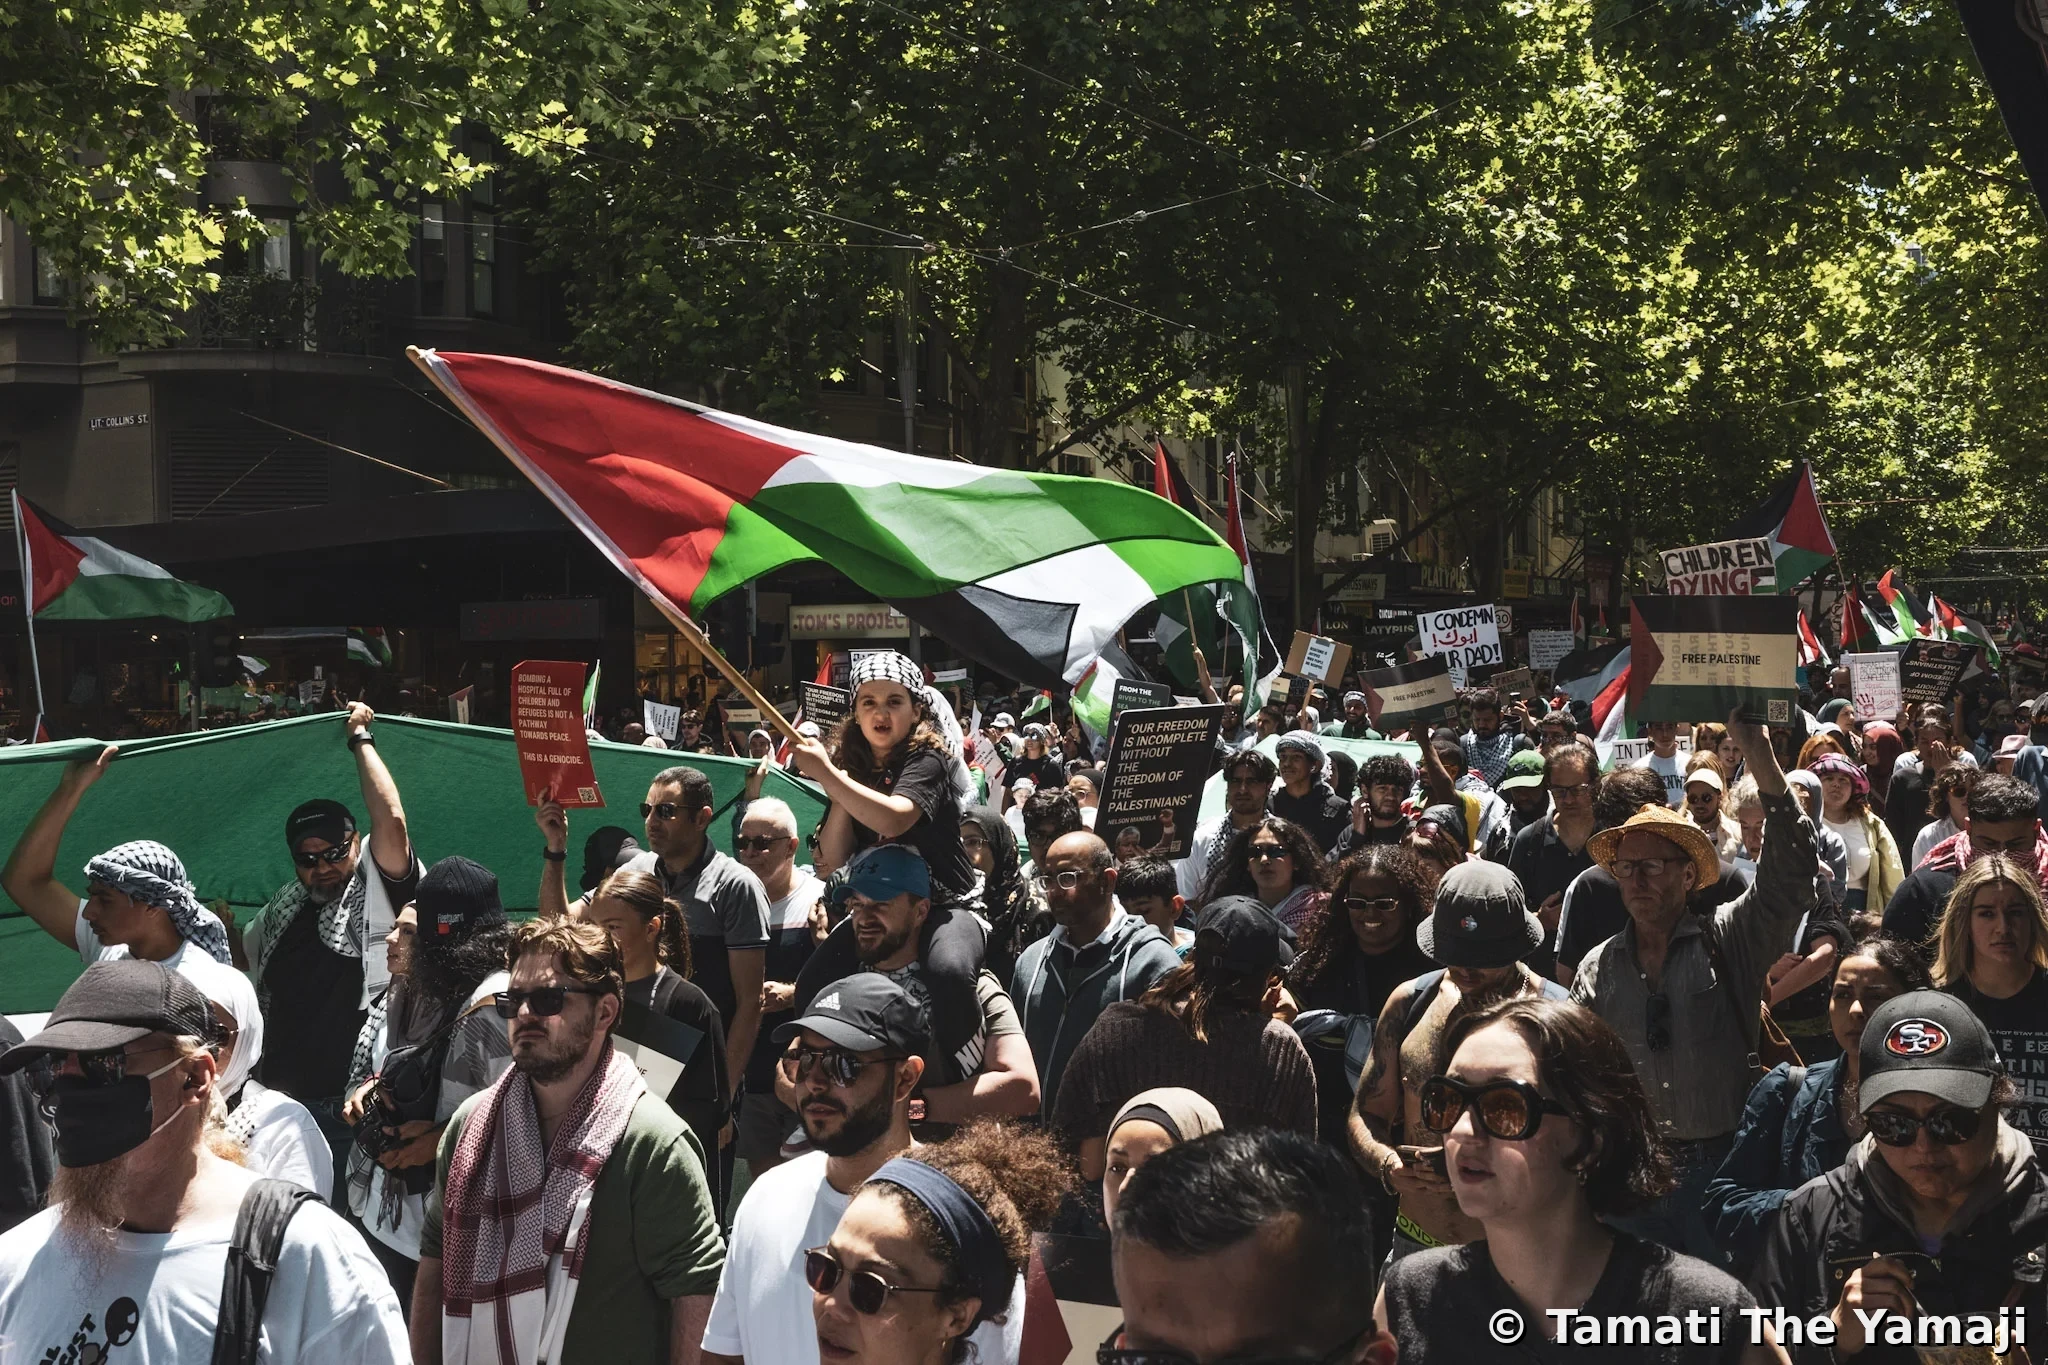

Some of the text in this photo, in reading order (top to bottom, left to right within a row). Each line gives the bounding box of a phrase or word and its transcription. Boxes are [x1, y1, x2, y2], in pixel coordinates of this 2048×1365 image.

[106, 416, 134, 426] COLLINS
[1664, 540, 1774, 577] CHILDREN
[1422, 565, 1468, 590] PLATYPUS
[1670, 568, 1750, 595] DYING
[1422, 606, 1494, 632] I CONDEMN
[1496, 614, 1508, 624] 30
[1424, 643, 1500, 668] YUR DAD!
[1682, 654, 1761, 665] FREE PALESTINE
[518, 674, 546, 683] BOMBING
[1921, 673, 1955, 681] FREEDOM
[518, 686, 572, 696] HOSPITAL FULL OF
[1119, 686, 1152, 696] FROM THE
[1406, 688, 1436, 699] PALESTINE
[518, 697, 560, 707] CHILDREN AND
[1118, 694, 1137, 702] RIVER
[518, 708, 574, 720] REFUGEES IS NOT A
[519, 719, 548, 728] PATHWAY
[1156, 718, 1210, 732] FREEDOM
[520, 730, 571, 742] TOWARDS PEACE.
[1123, 731, 1208, 748] IS INCOMPLETE
[523, 752, 584, 764] THIS IS A GENOCIDE.
[1120, 746, 1172, 760] WITHOUT
[1615, 744, 1632, 760] IN
[1118, 762, 1140, 773] THE
[1114, 770, 1184, 786] FREEDOM OF
[1112, 787, 1134, 800] THE
[1130, 814, 1156, 822] MANDELA
